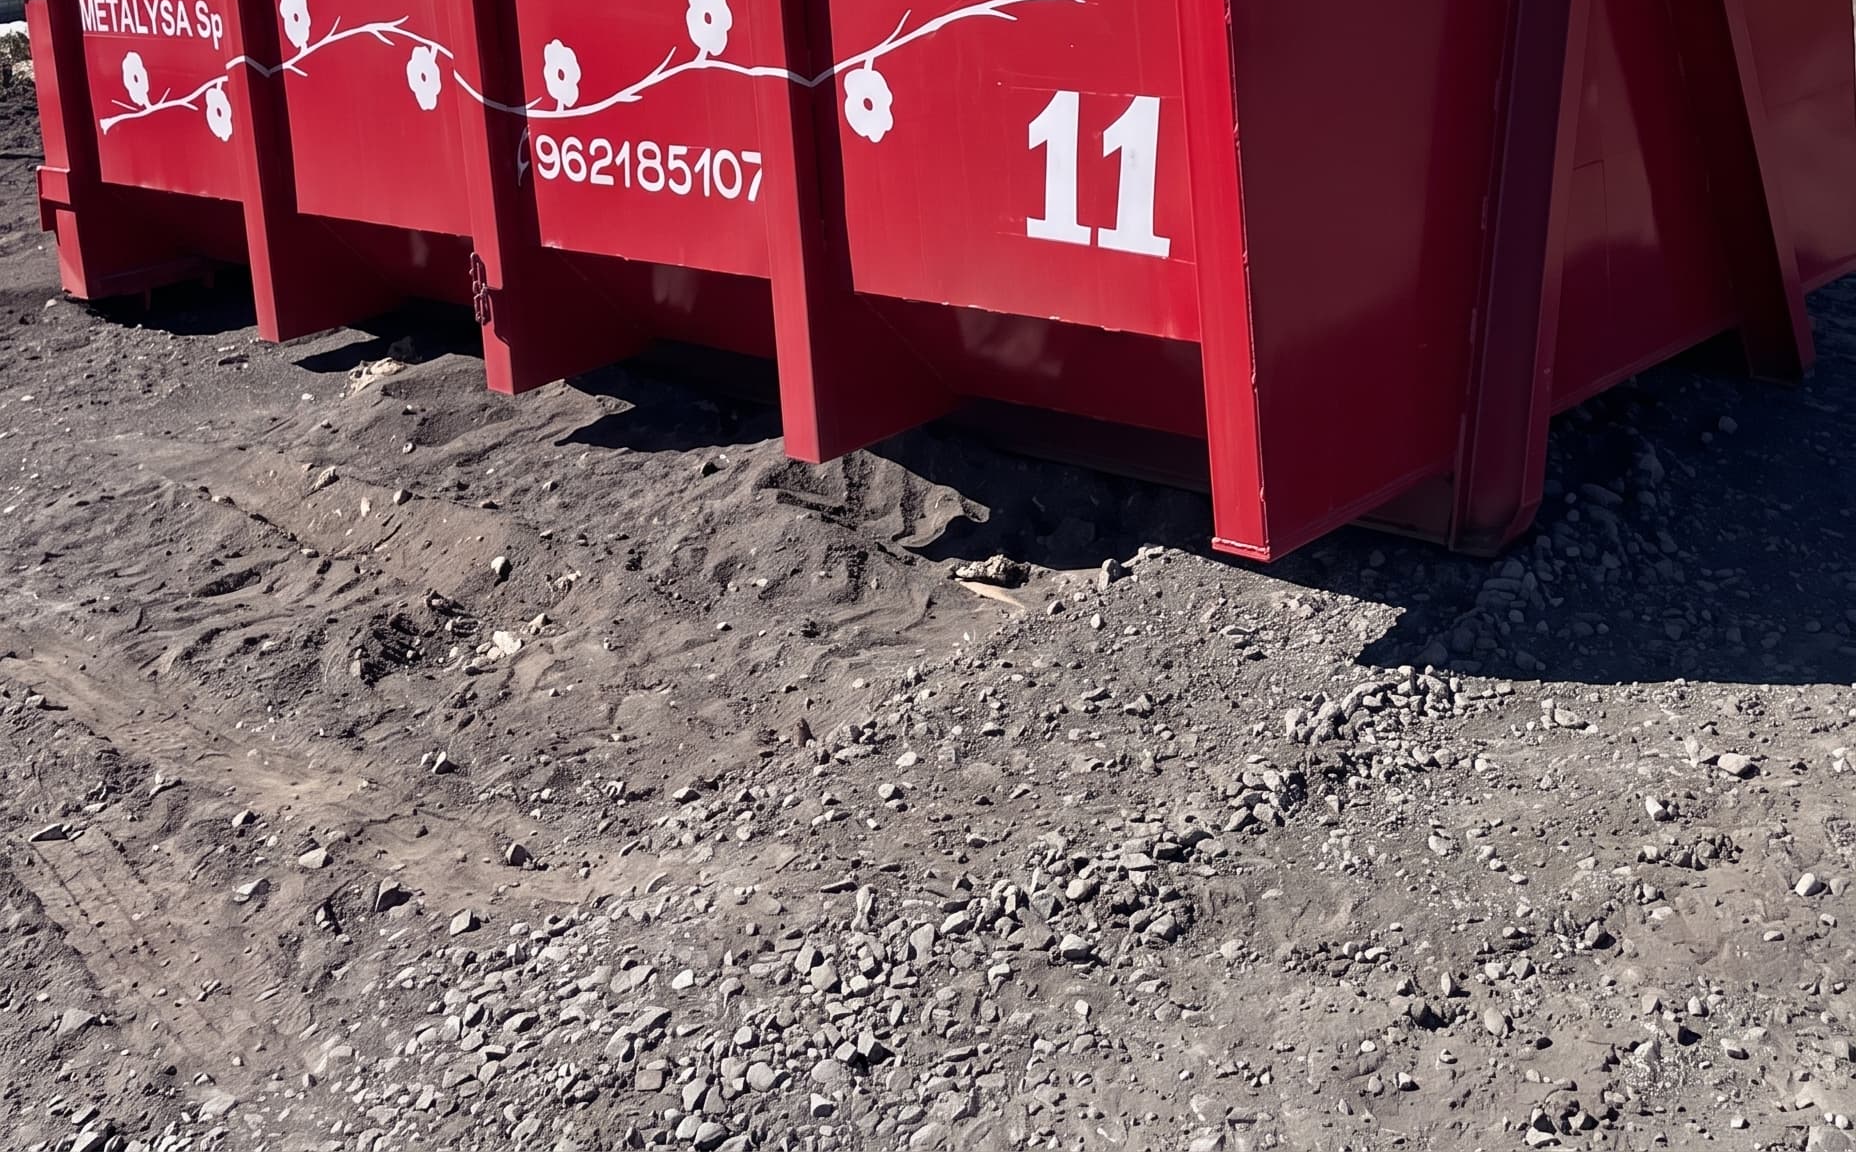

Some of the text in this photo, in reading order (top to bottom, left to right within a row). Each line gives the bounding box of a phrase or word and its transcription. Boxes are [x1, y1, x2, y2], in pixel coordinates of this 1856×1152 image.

[196, 0, 223, 49] Sp
[535, 134, 763, 203] 962185107
[1026, 89, 1171, 258] 11
